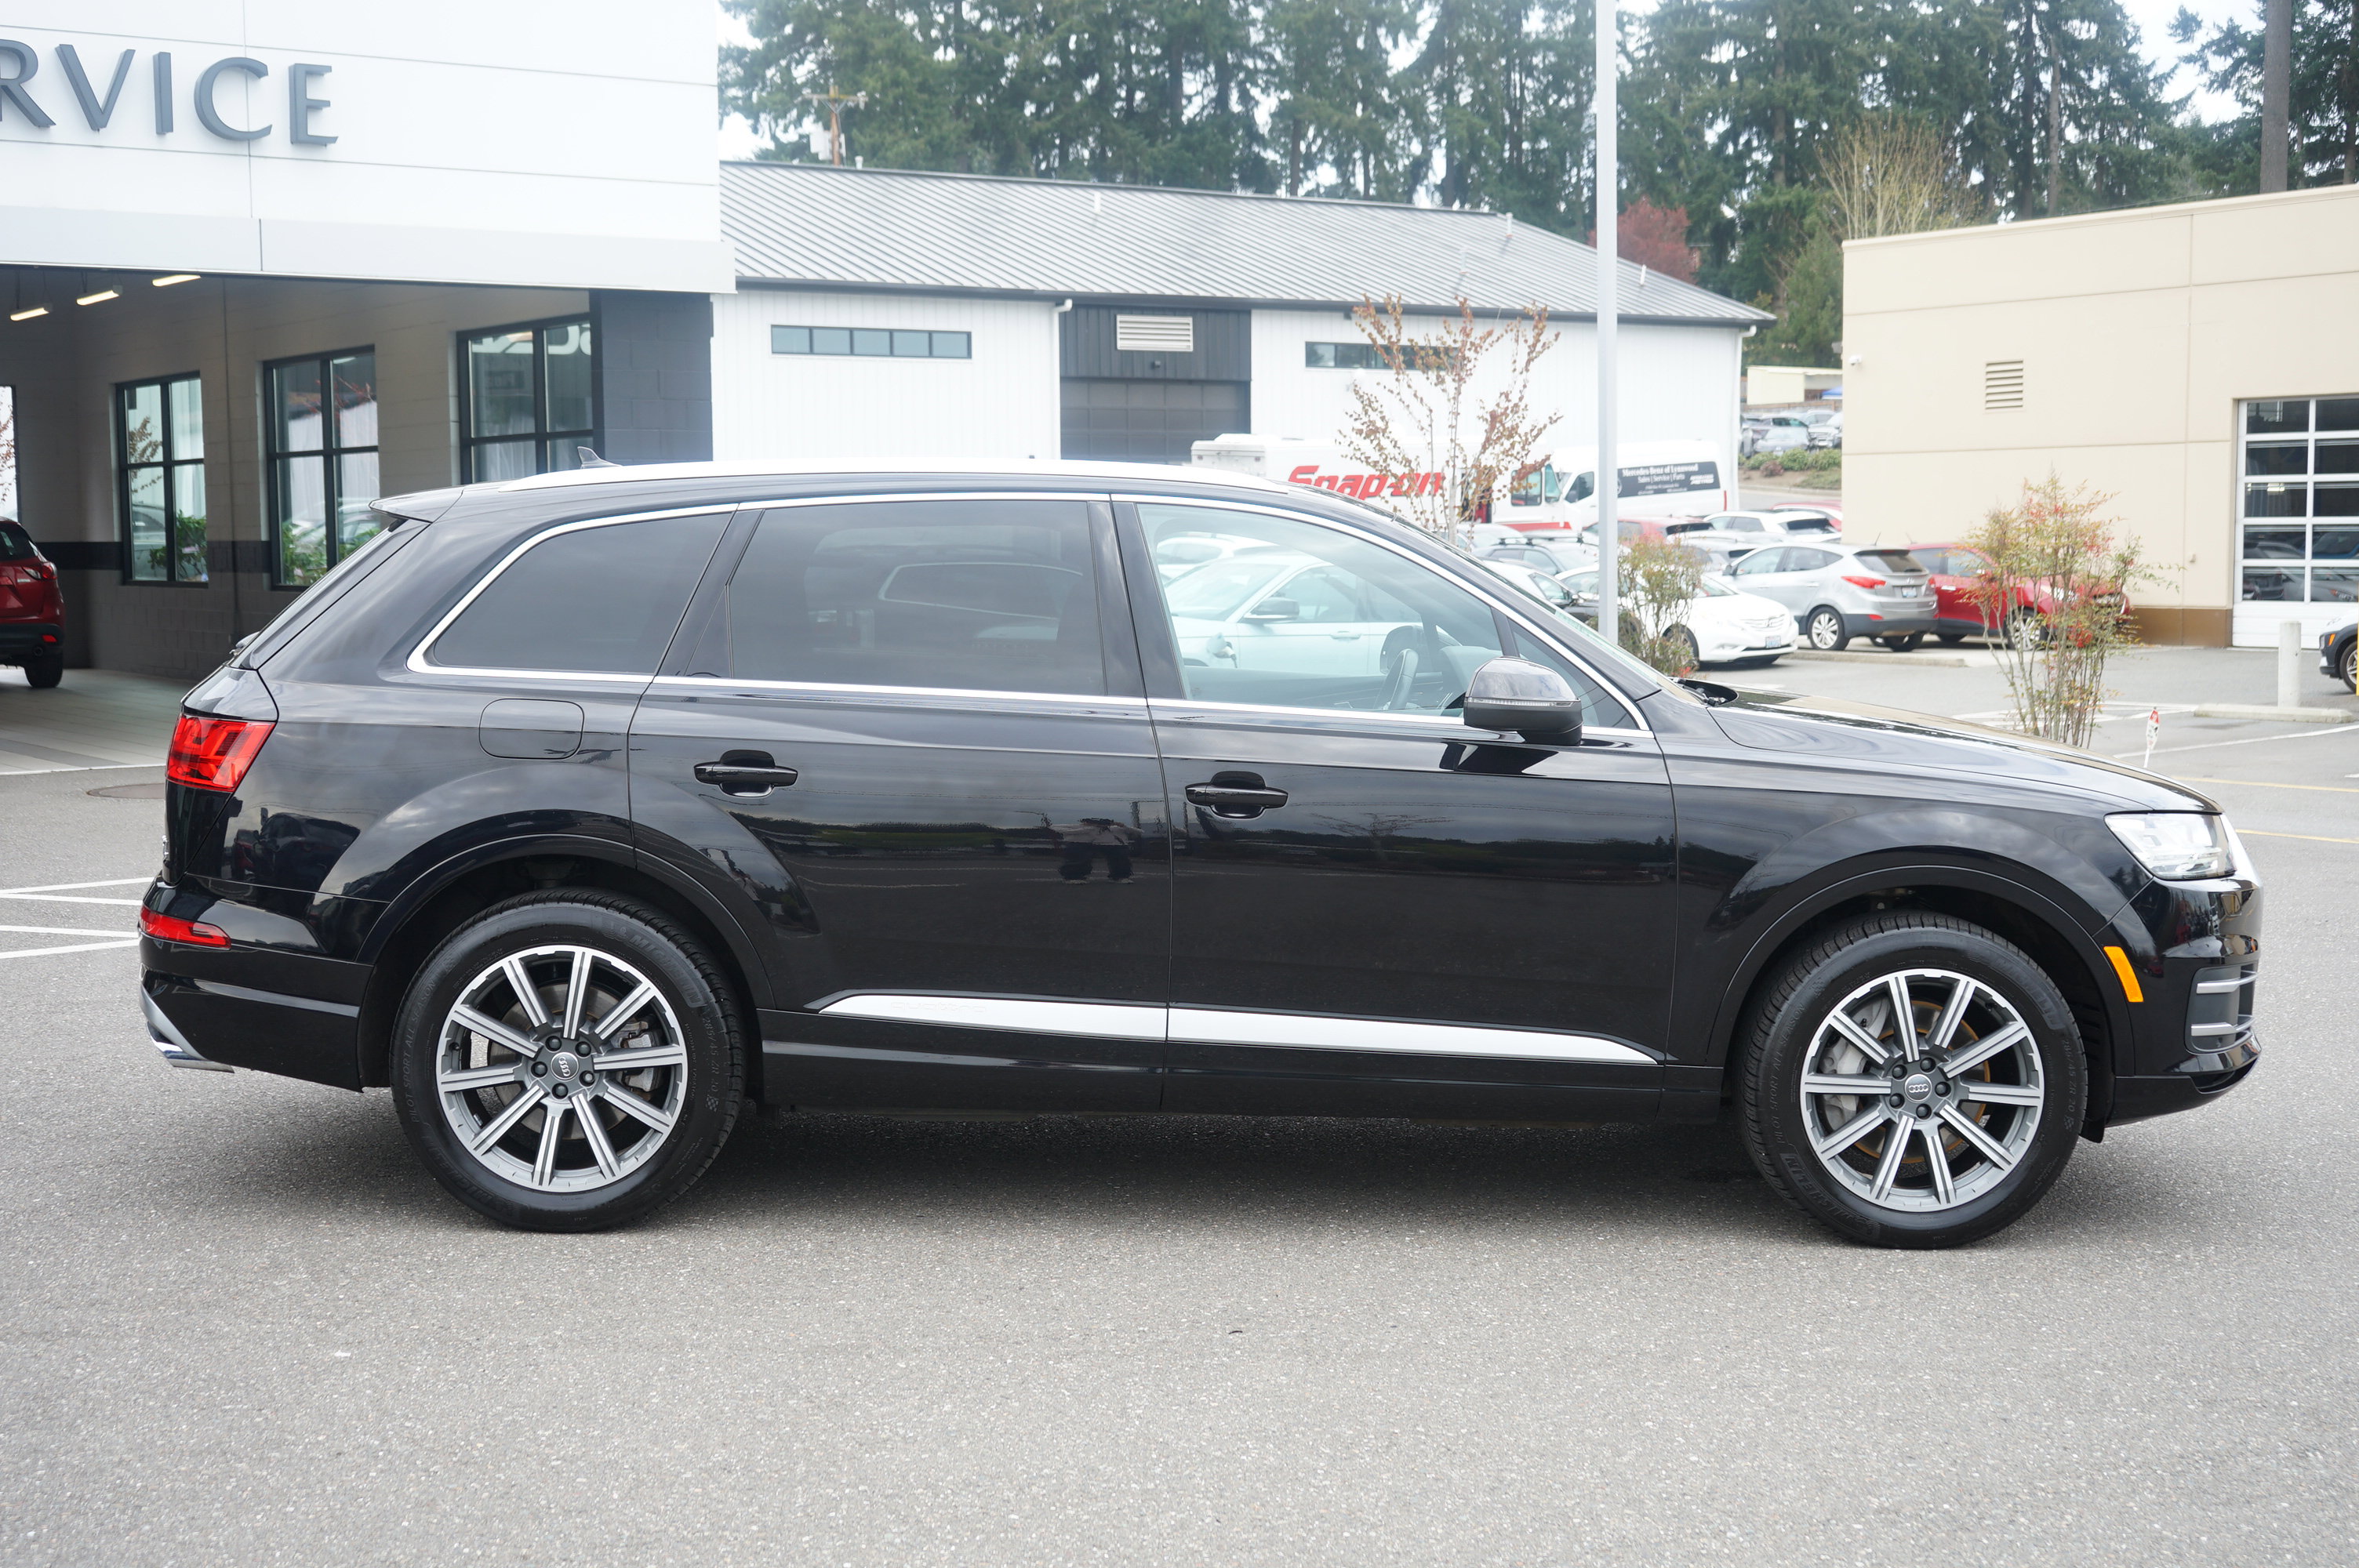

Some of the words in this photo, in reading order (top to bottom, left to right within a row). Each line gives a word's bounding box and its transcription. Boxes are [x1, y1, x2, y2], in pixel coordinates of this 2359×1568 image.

[0, 38, 339, 147] RVICE
[630, 934, 701, 1004] MICHELIN
[413, 979, 435, 1023] SEASON
[405, 1028, 416, 1047] ALL
[1779, 1003, 1805, 1047] SEASON
[1772, 1051, 1783, 1071] ALL
[405, 1094, 420, 1123] PILOT
[1769, 1075, 1779, 1110] SPORT
[1772, 1116, 1786, 1143] PILOT
